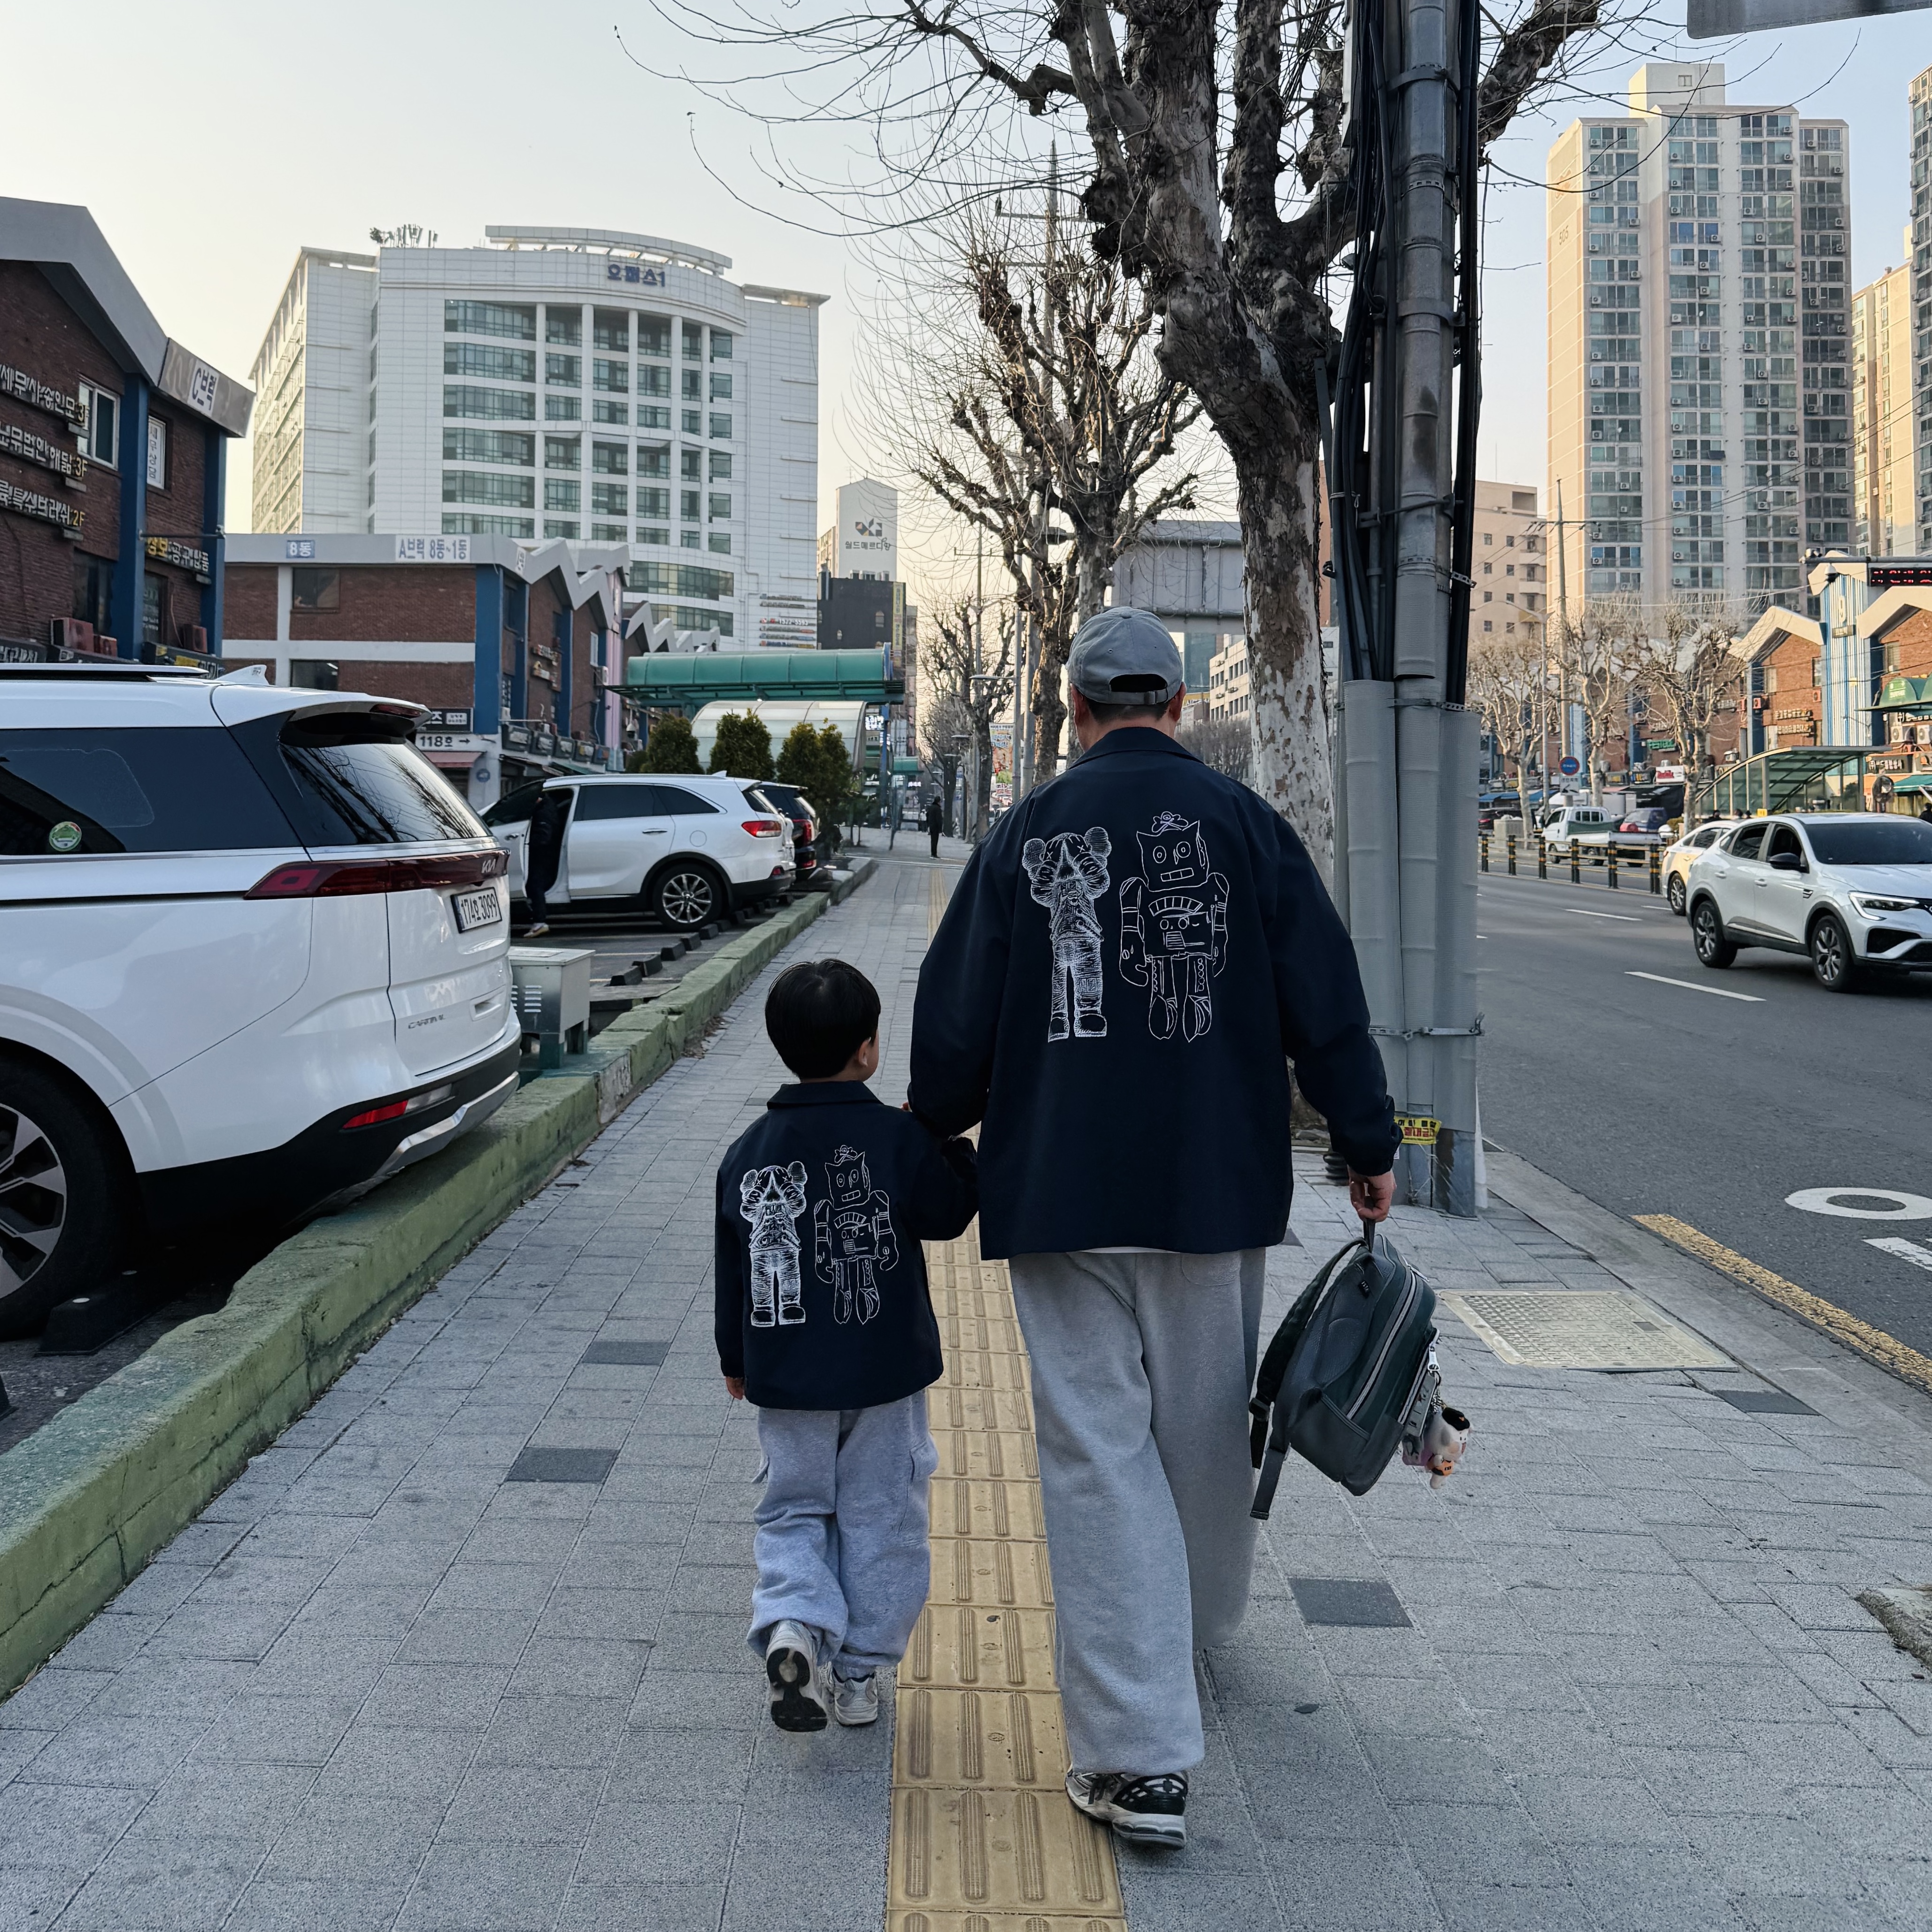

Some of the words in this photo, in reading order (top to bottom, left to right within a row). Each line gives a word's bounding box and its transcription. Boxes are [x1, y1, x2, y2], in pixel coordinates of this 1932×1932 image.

[75, 456, 88, 477] 3F
[73, 509, 86, 527] 2F
[289, 541, 312, 557] 8동
[420, 735, 454, 747] 118호
[478, 893, 498, 920] 3099
